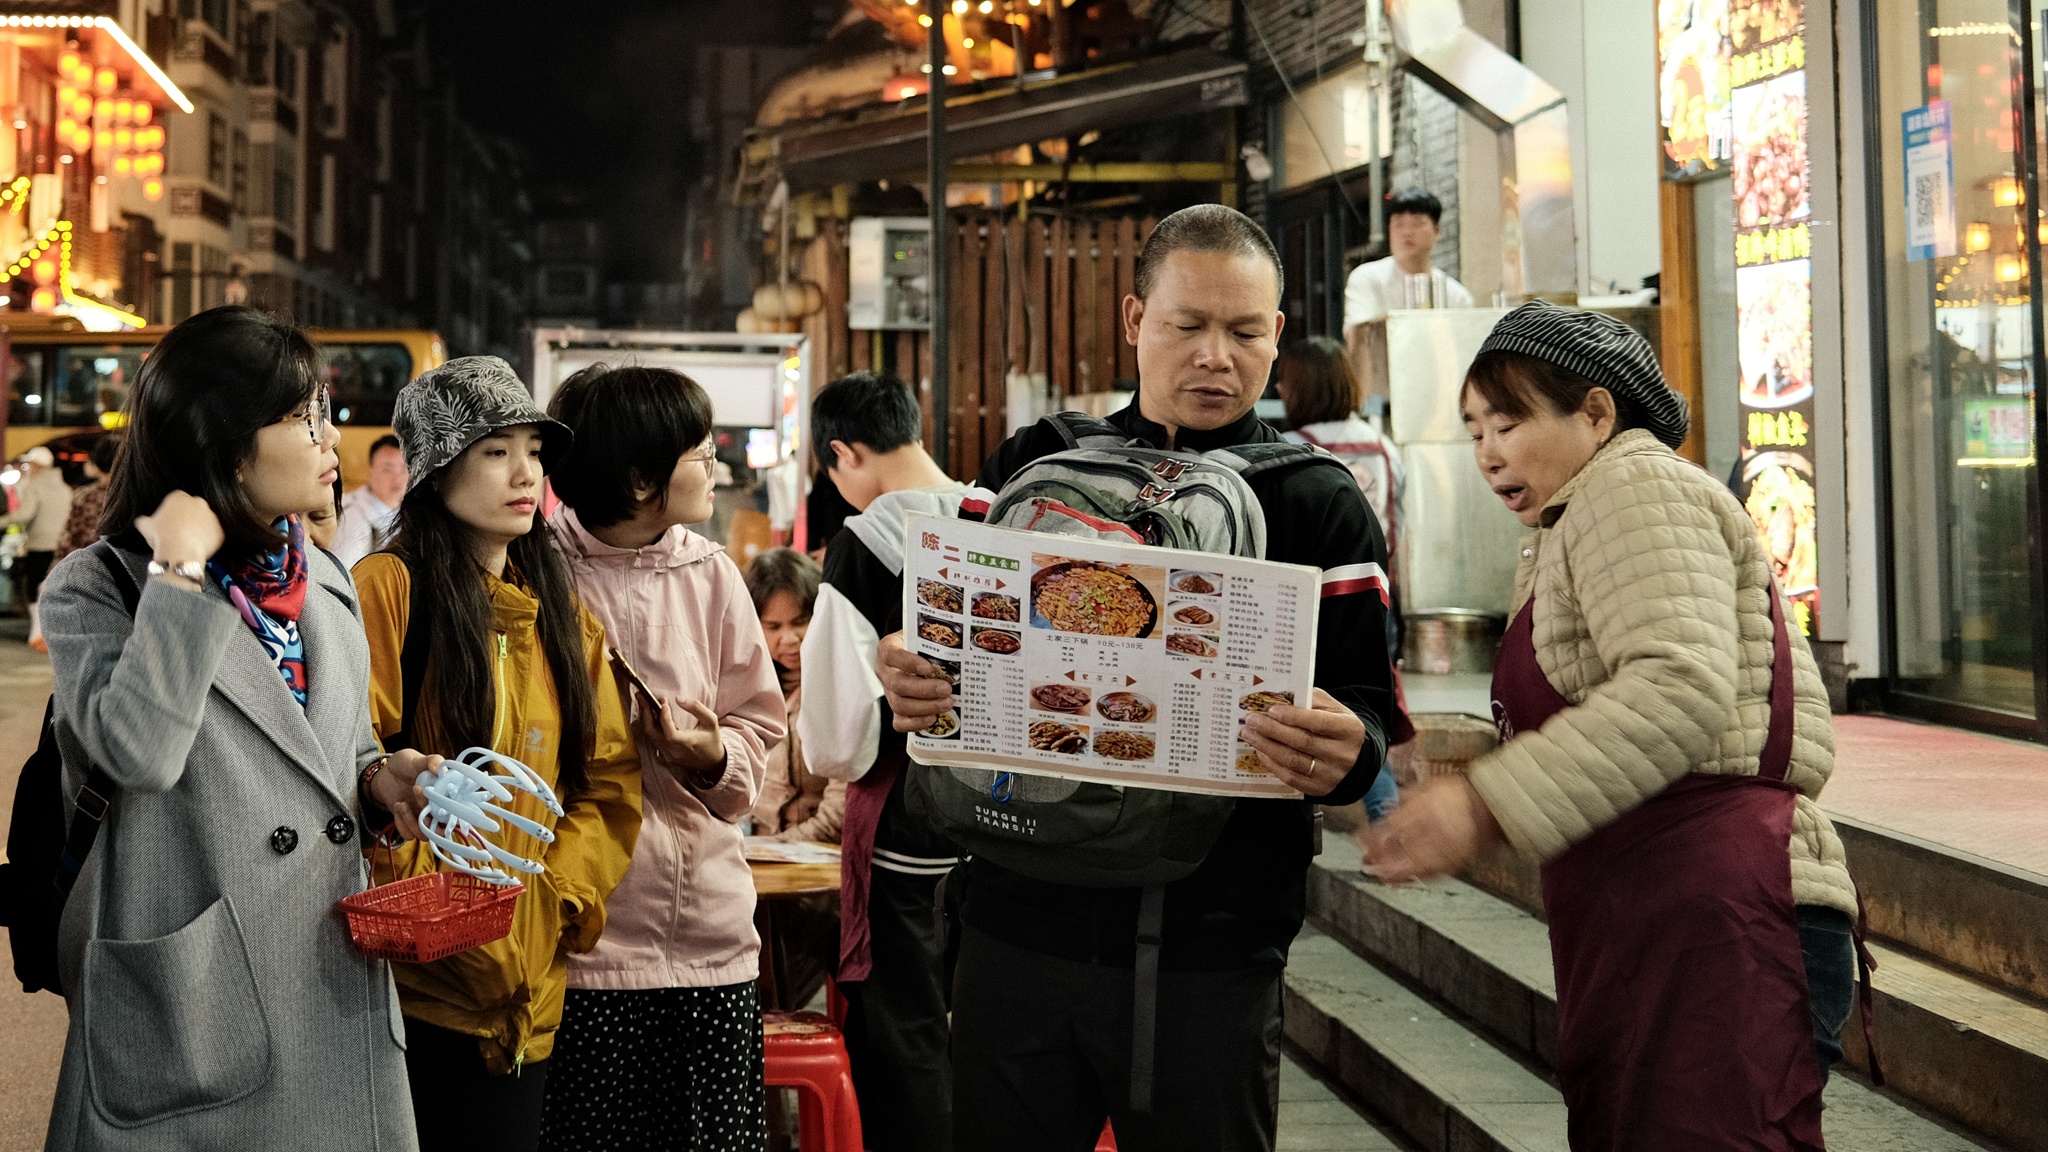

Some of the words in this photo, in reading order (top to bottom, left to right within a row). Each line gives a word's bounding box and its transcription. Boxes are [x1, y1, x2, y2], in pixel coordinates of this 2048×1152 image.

[1046, 634, 1088, 645] 土家三下锅
[975, 806, 1018, 822] SURGE
[976, 814, 1036, 835] TRANSIT
